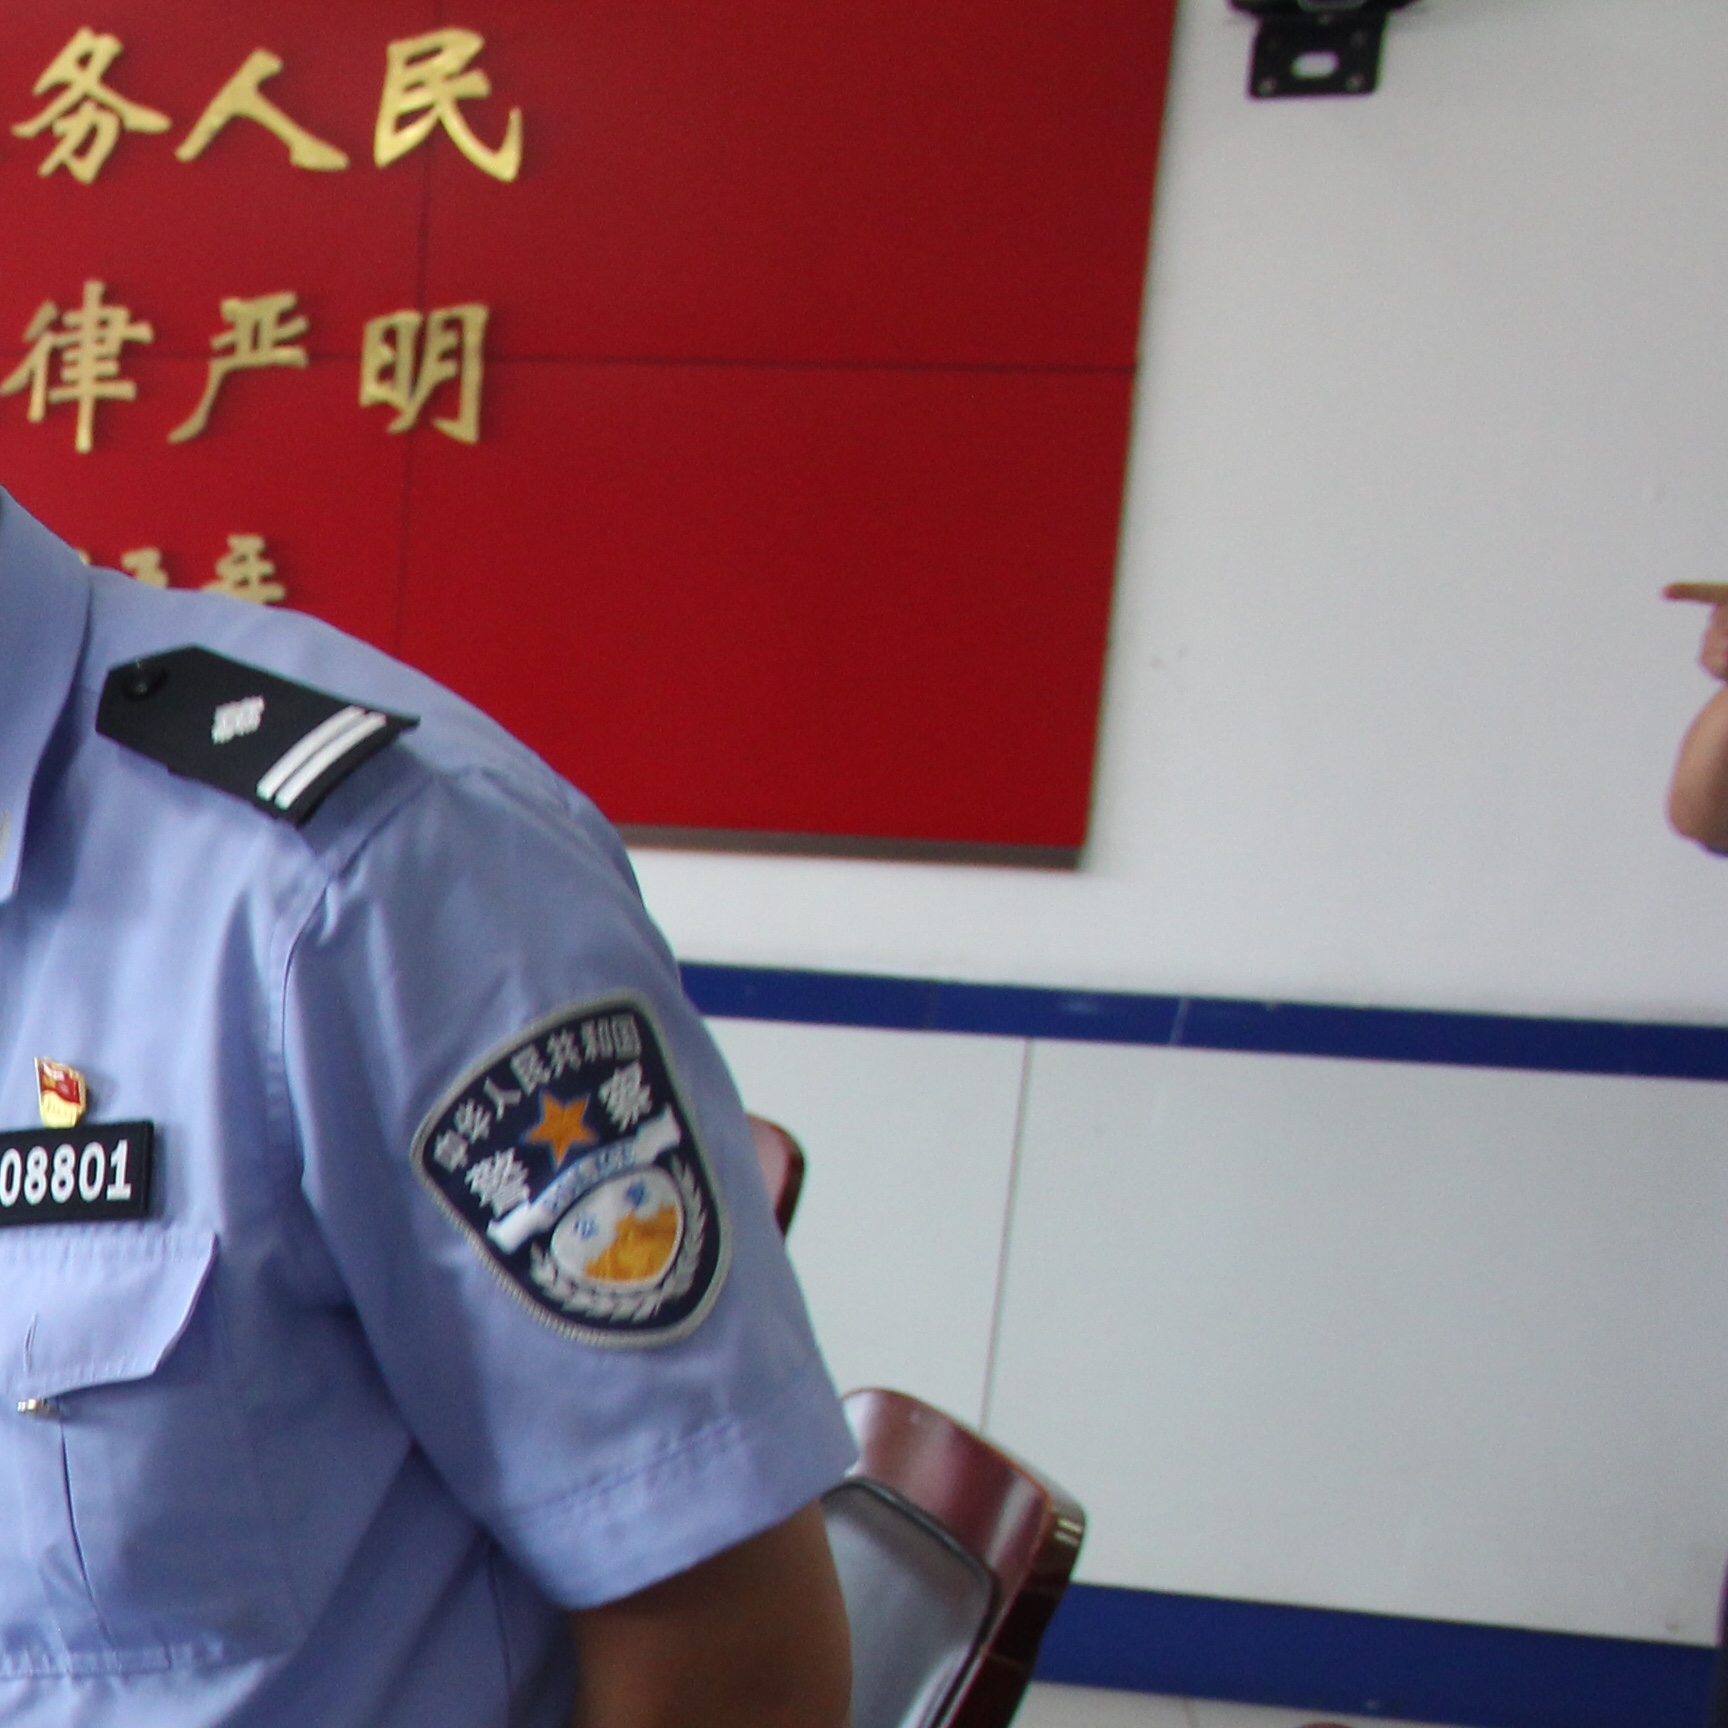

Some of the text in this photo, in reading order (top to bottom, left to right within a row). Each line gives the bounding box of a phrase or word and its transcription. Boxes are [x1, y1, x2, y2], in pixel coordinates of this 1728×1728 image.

[433, 1013, 643, 1174] 中华人民共和国
